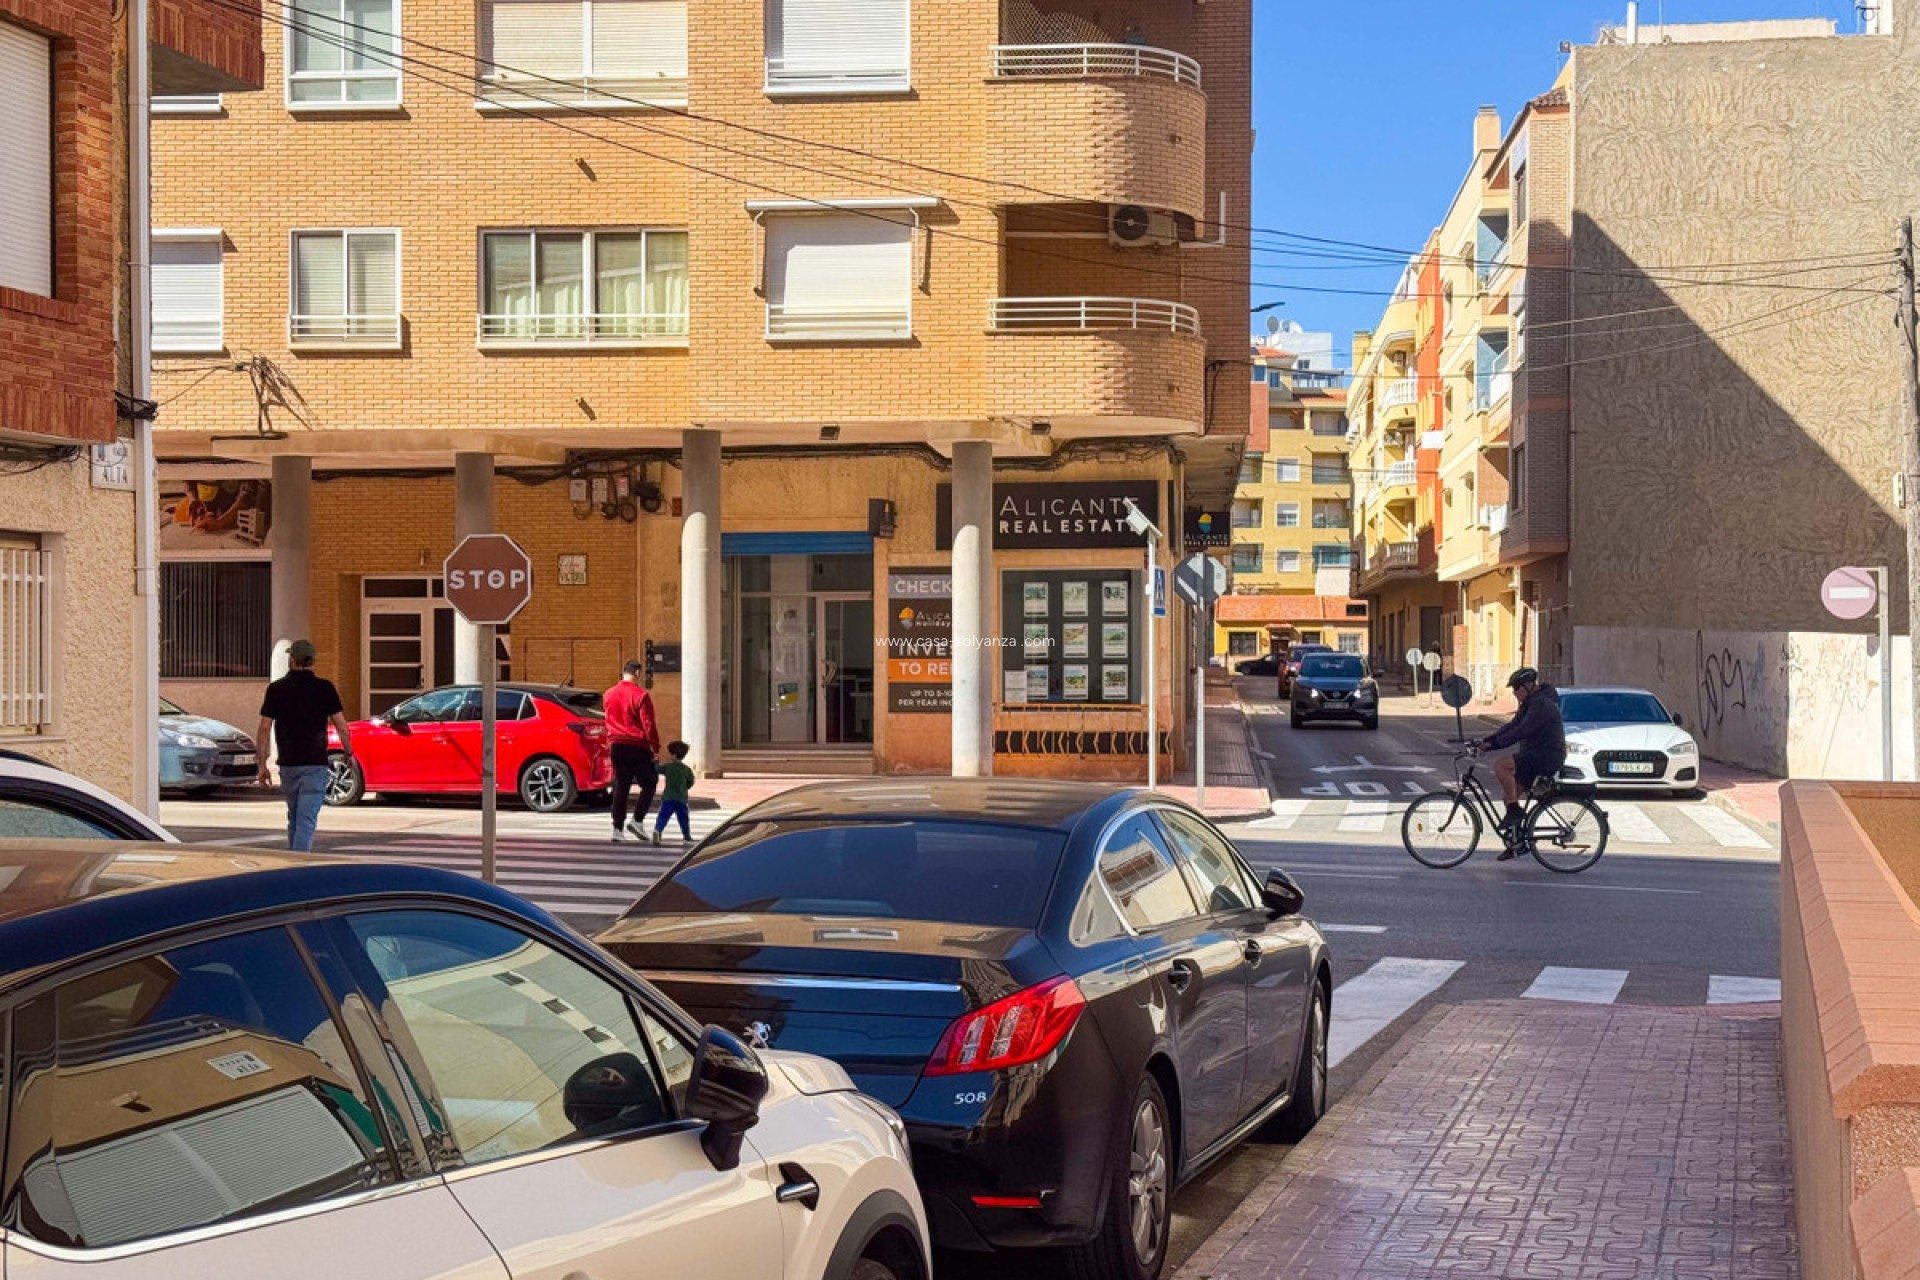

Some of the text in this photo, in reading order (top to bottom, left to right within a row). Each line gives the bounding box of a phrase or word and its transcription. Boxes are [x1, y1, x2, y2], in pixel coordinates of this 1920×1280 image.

[999, 519, 1137, 534] REAL ESTAT
[449, 569, 526, 590] STOP
[899, 643, 952, 656] INVE
[899, 662, 952, 675] TO RE
[953, 1091, 987, 1105] 508
